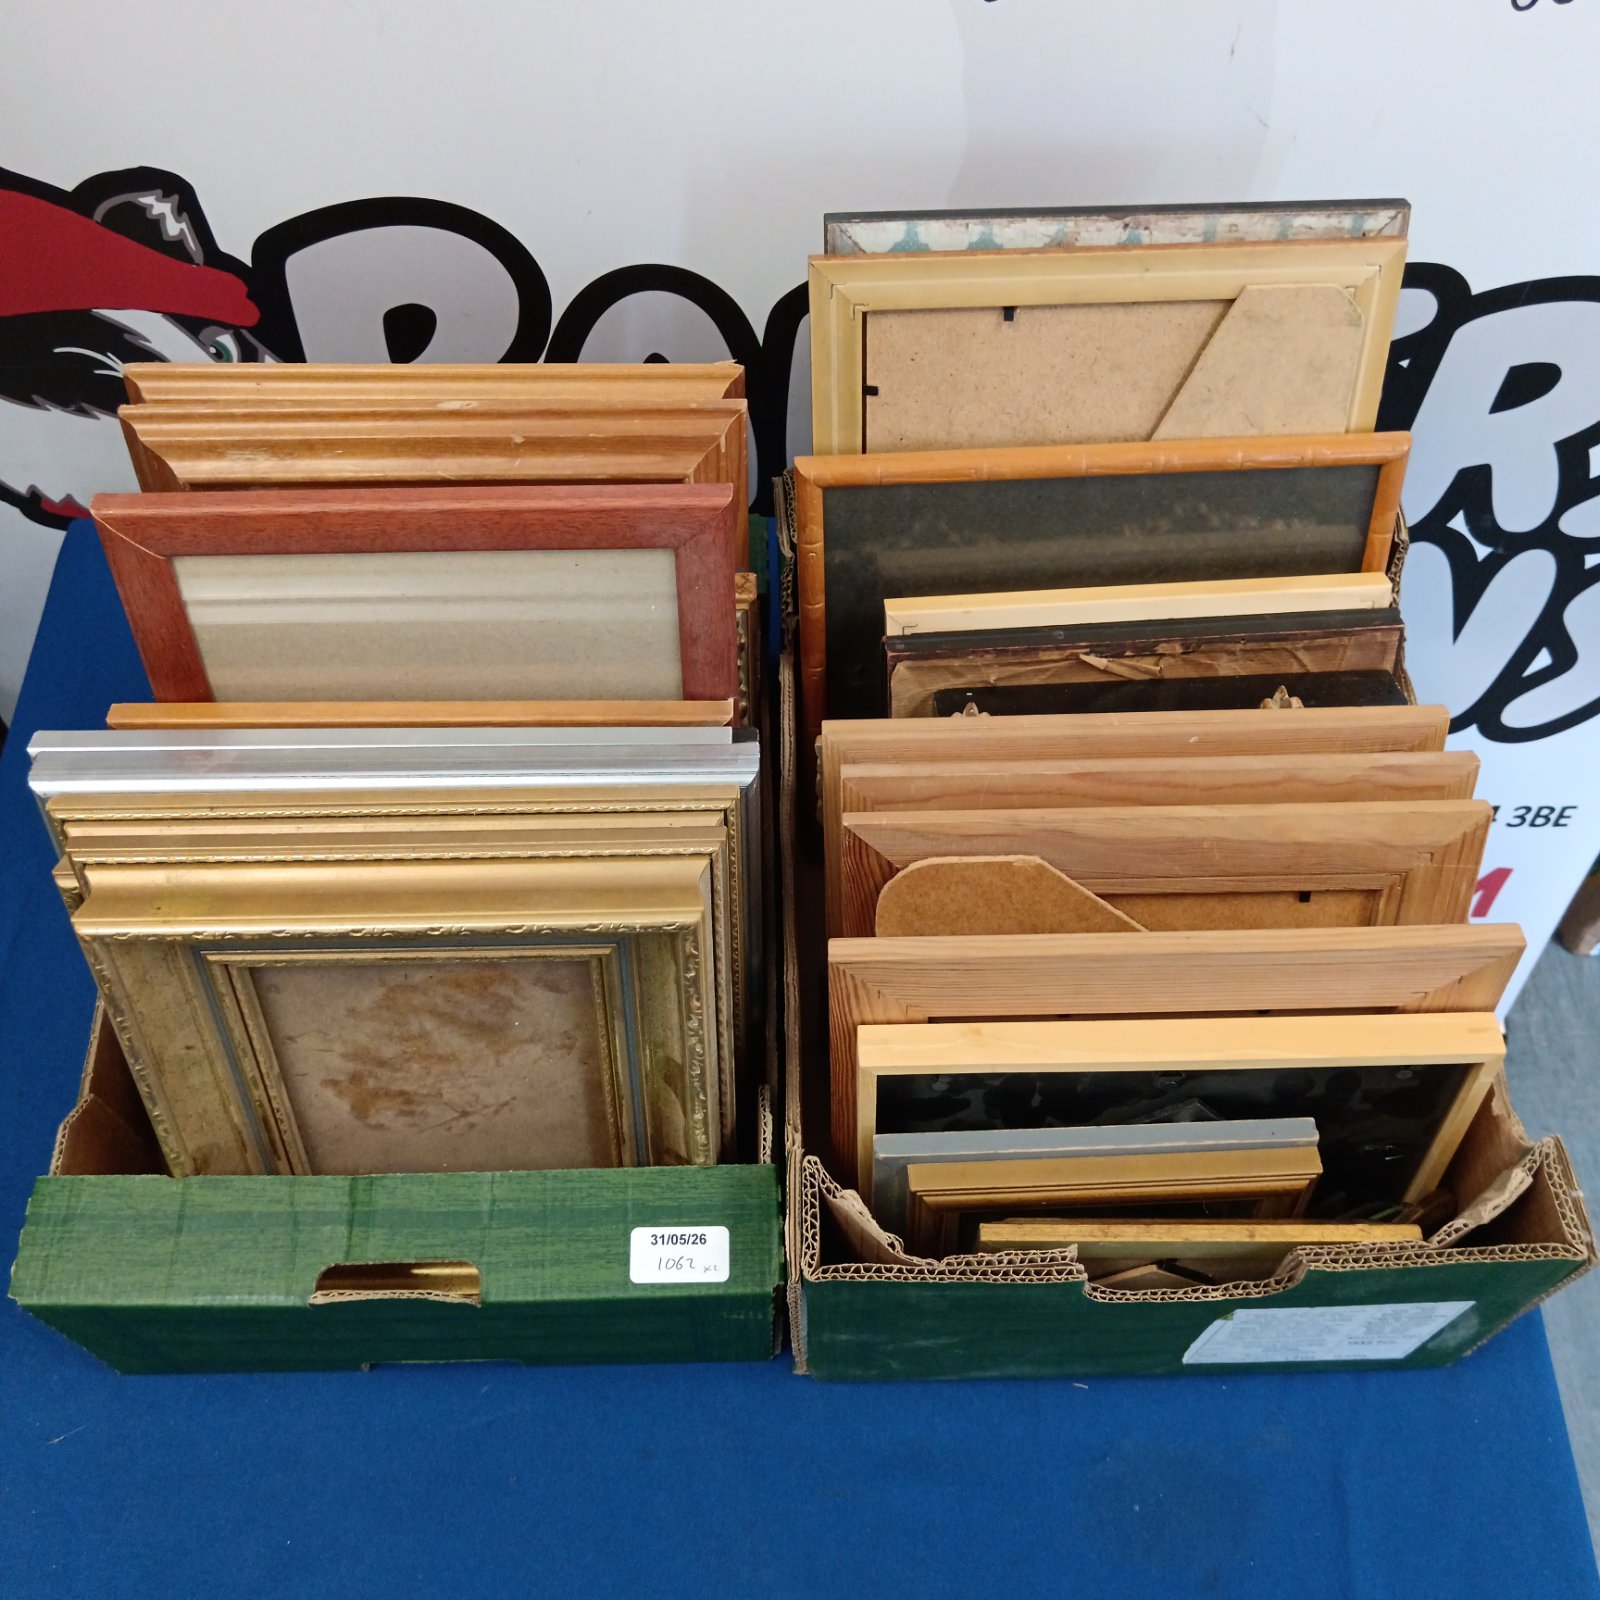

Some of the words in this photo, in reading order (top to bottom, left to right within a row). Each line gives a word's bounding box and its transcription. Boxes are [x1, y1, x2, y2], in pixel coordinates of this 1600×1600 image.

[1505, 805, 1578, 828] 3BE
[650, 1233, 707, 1246] 31/05/26
[658, 1256, 697, 1271] 1062
